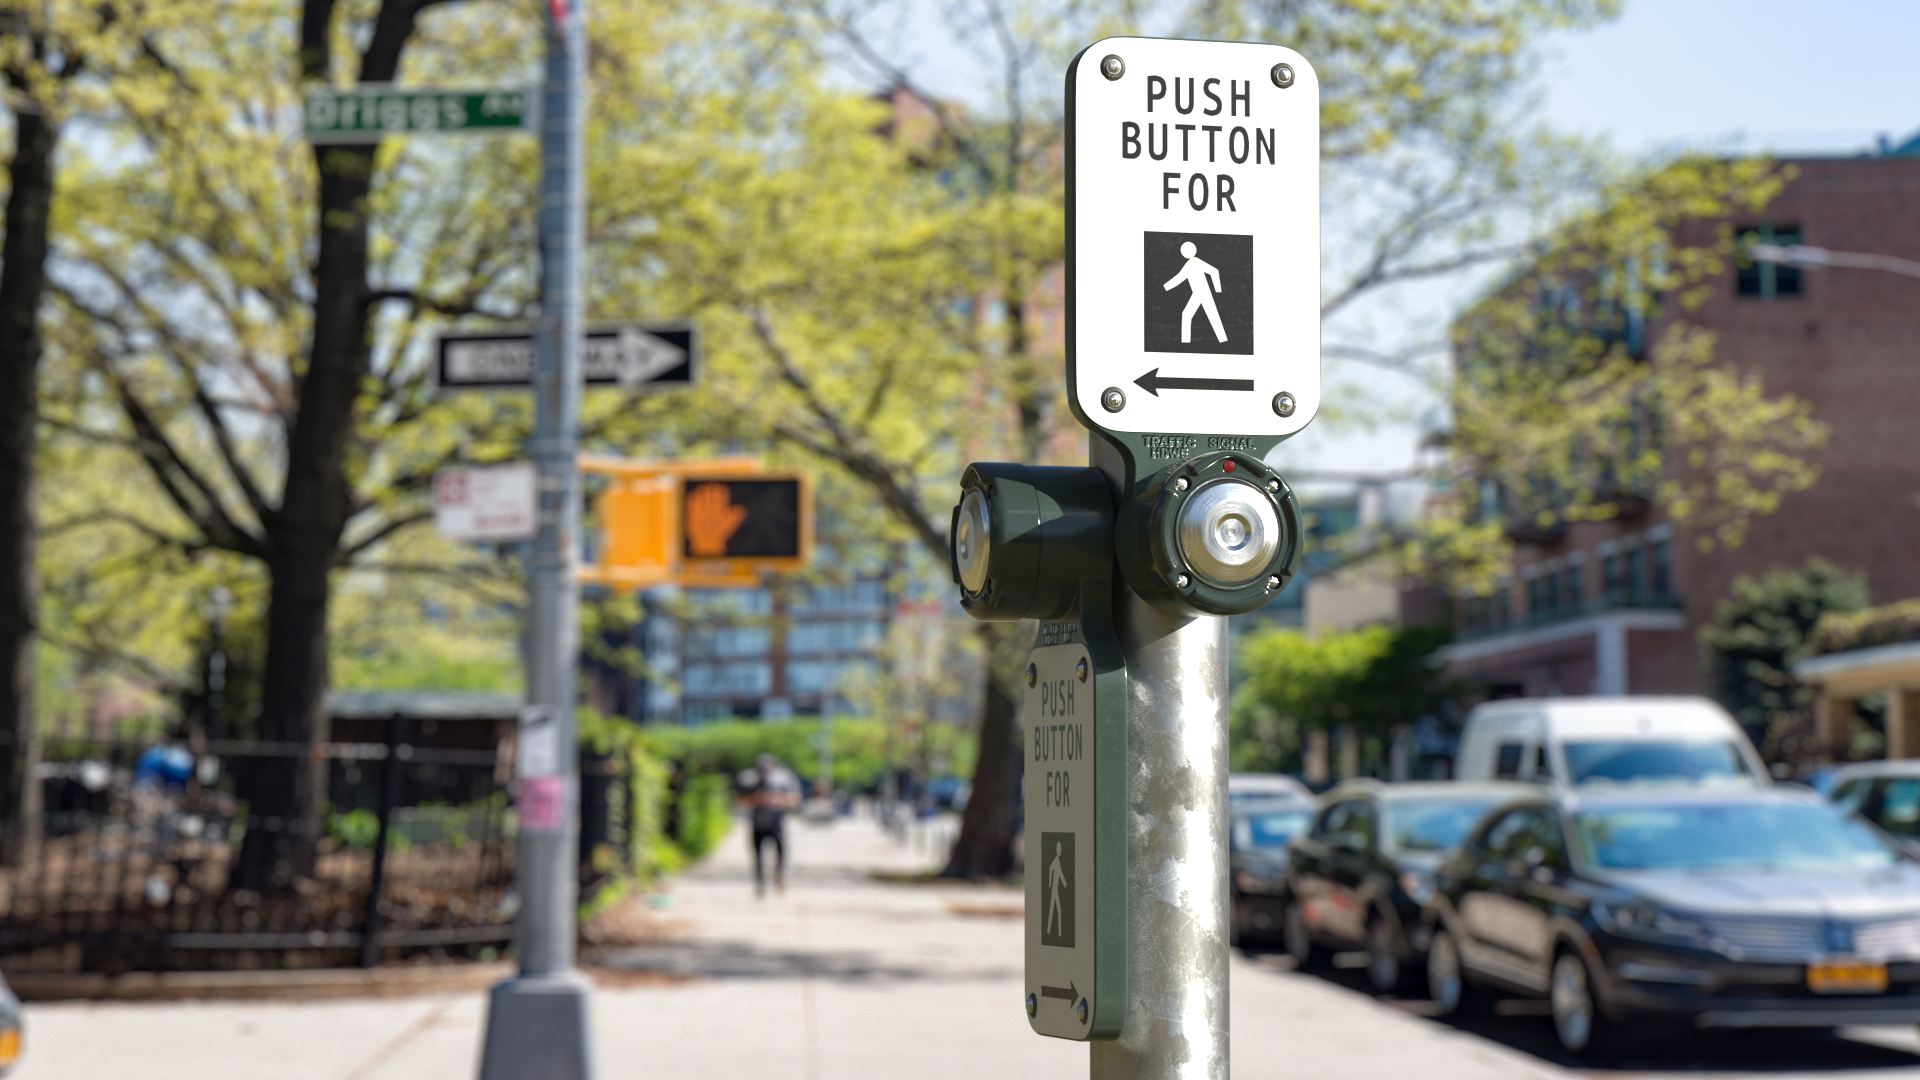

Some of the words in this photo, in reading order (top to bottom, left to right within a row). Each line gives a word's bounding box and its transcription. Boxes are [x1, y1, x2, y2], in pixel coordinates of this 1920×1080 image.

[308, 90, 470, 131] Driggs
[1147, 75, 1250, 117] PUSH
[1122, 121, 1275, 165] BUTTON
[1163, 172, 1237, 212] FOR
[1141, 435, 1197, 449] TRAFFIC
[1208, 436, 1256, 451] SIGNAL
[1042, 679, 1075, 717] PUSH
[1034, 723, 1083, 762] BUTTON
[1046, 770, 1070, 808] FOR
